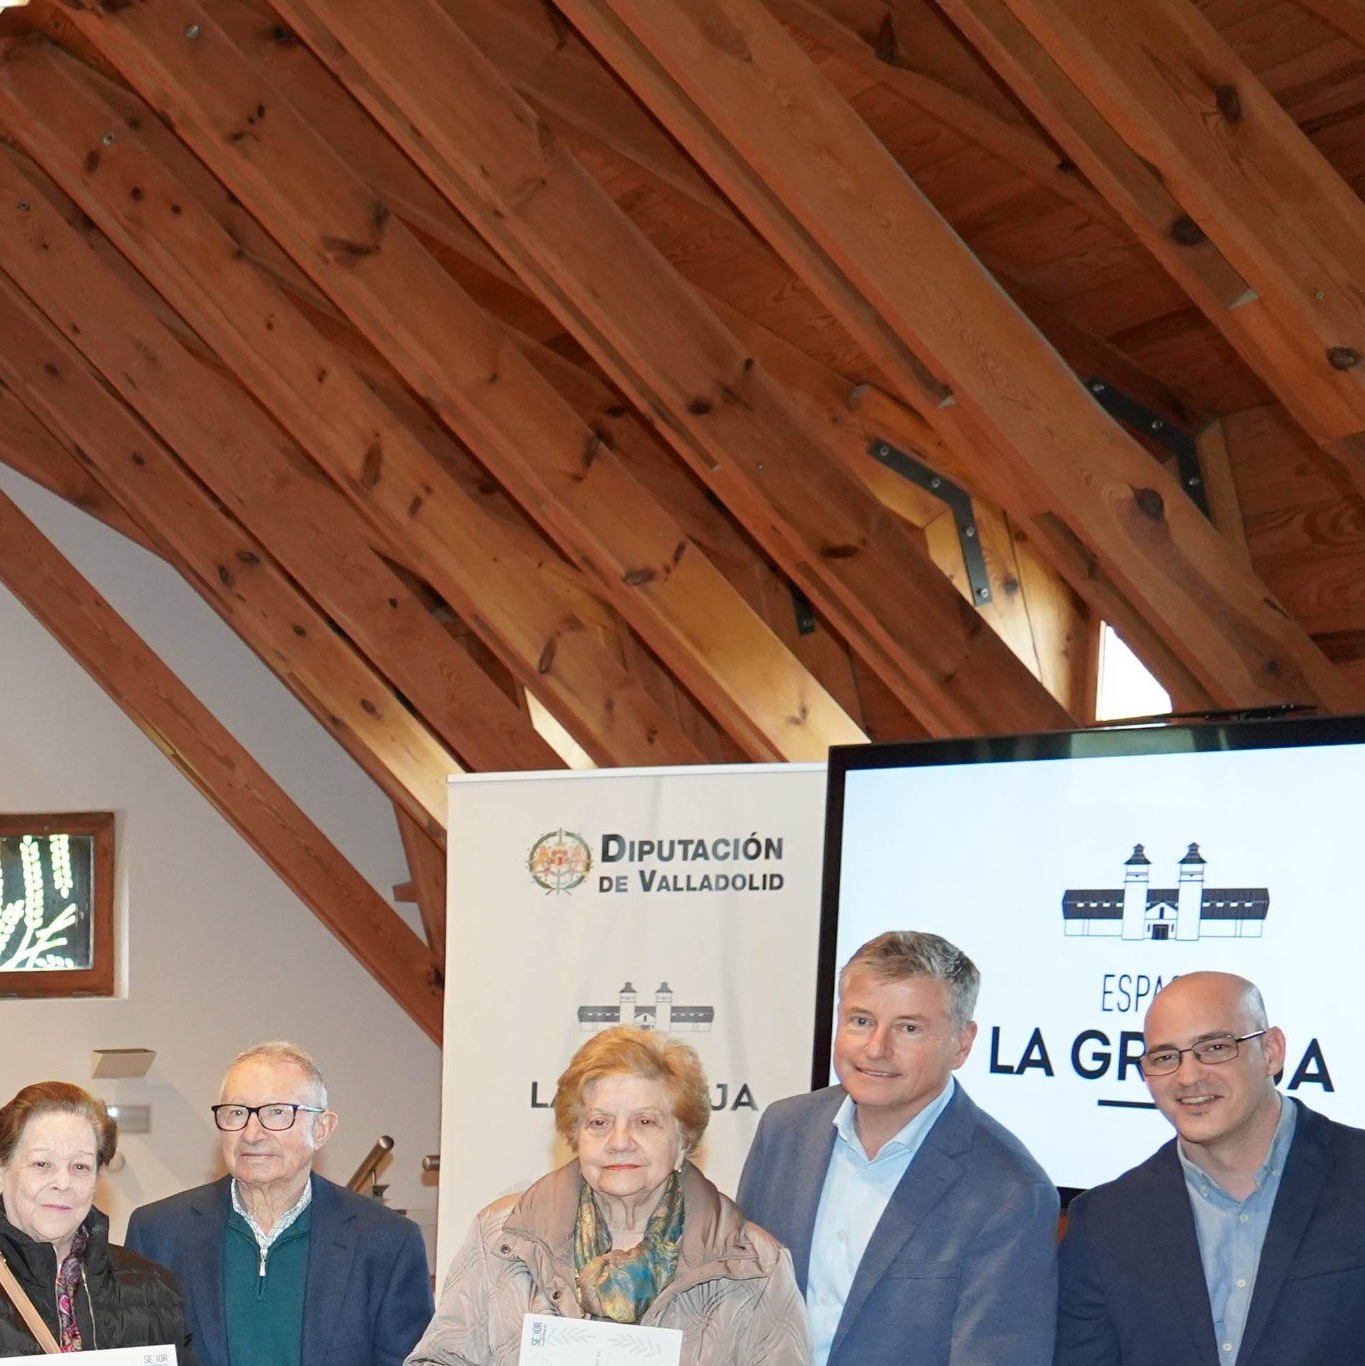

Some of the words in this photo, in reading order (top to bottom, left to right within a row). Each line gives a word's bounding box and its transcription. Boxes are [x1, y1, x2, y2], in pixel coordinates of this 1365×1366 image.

[601, 833, 783, 863] DIPUTACIÓN
[599, 875, 628, 893] DE
[639, 870, 784, 893] VALLADOLID
[990, 1026, 1054, 1077] LA
